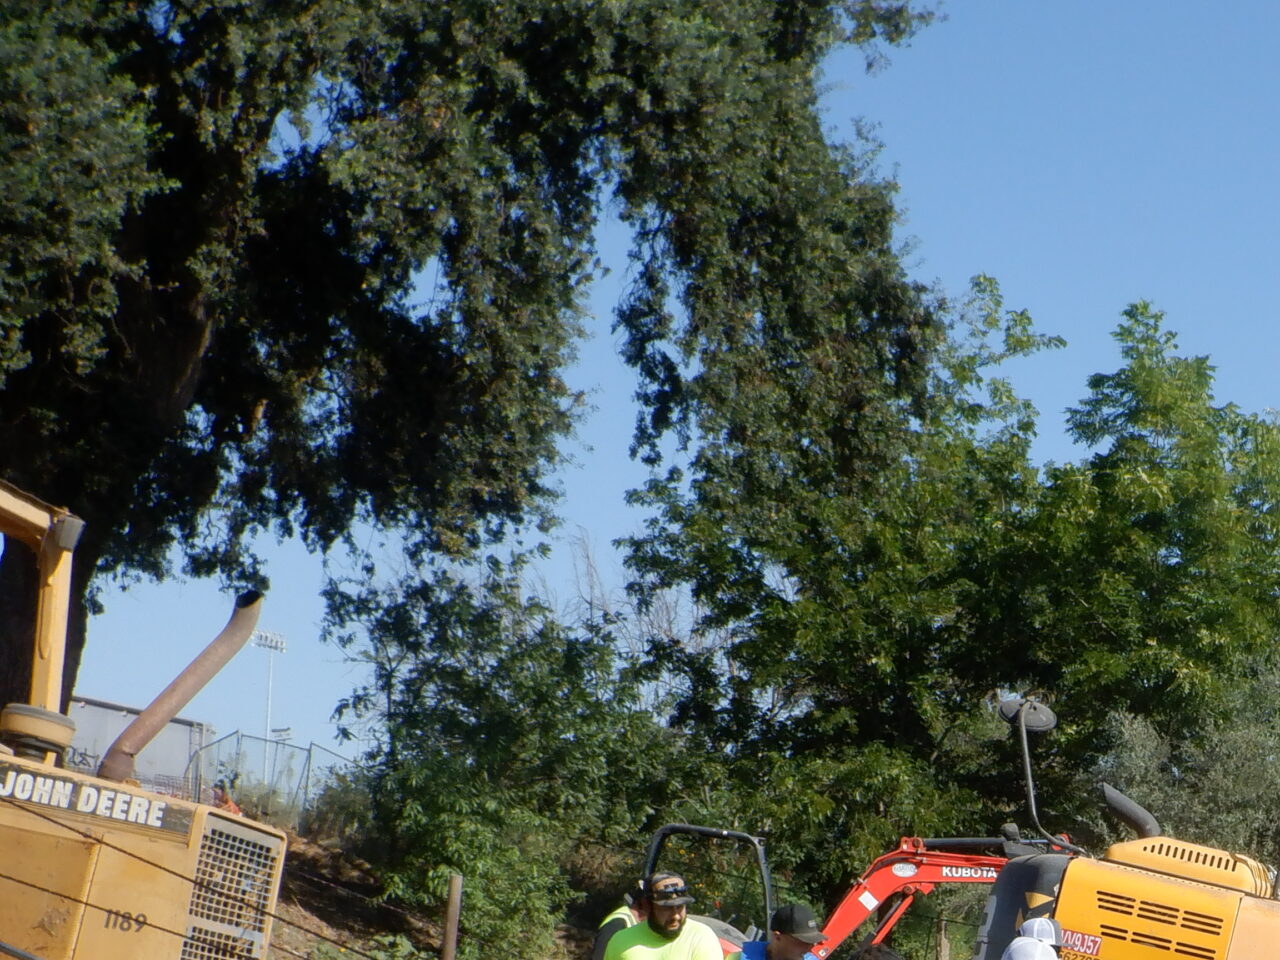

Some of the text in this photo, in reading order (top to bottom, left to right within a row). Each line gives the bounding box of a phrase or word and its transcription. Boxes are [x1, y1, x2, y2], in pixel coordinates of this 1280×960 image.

[0, 770, 167, 828] JOHN DEERE
[941, 866, 998, 878] KUBOTA
[104, 908, 147, 933] 1189
